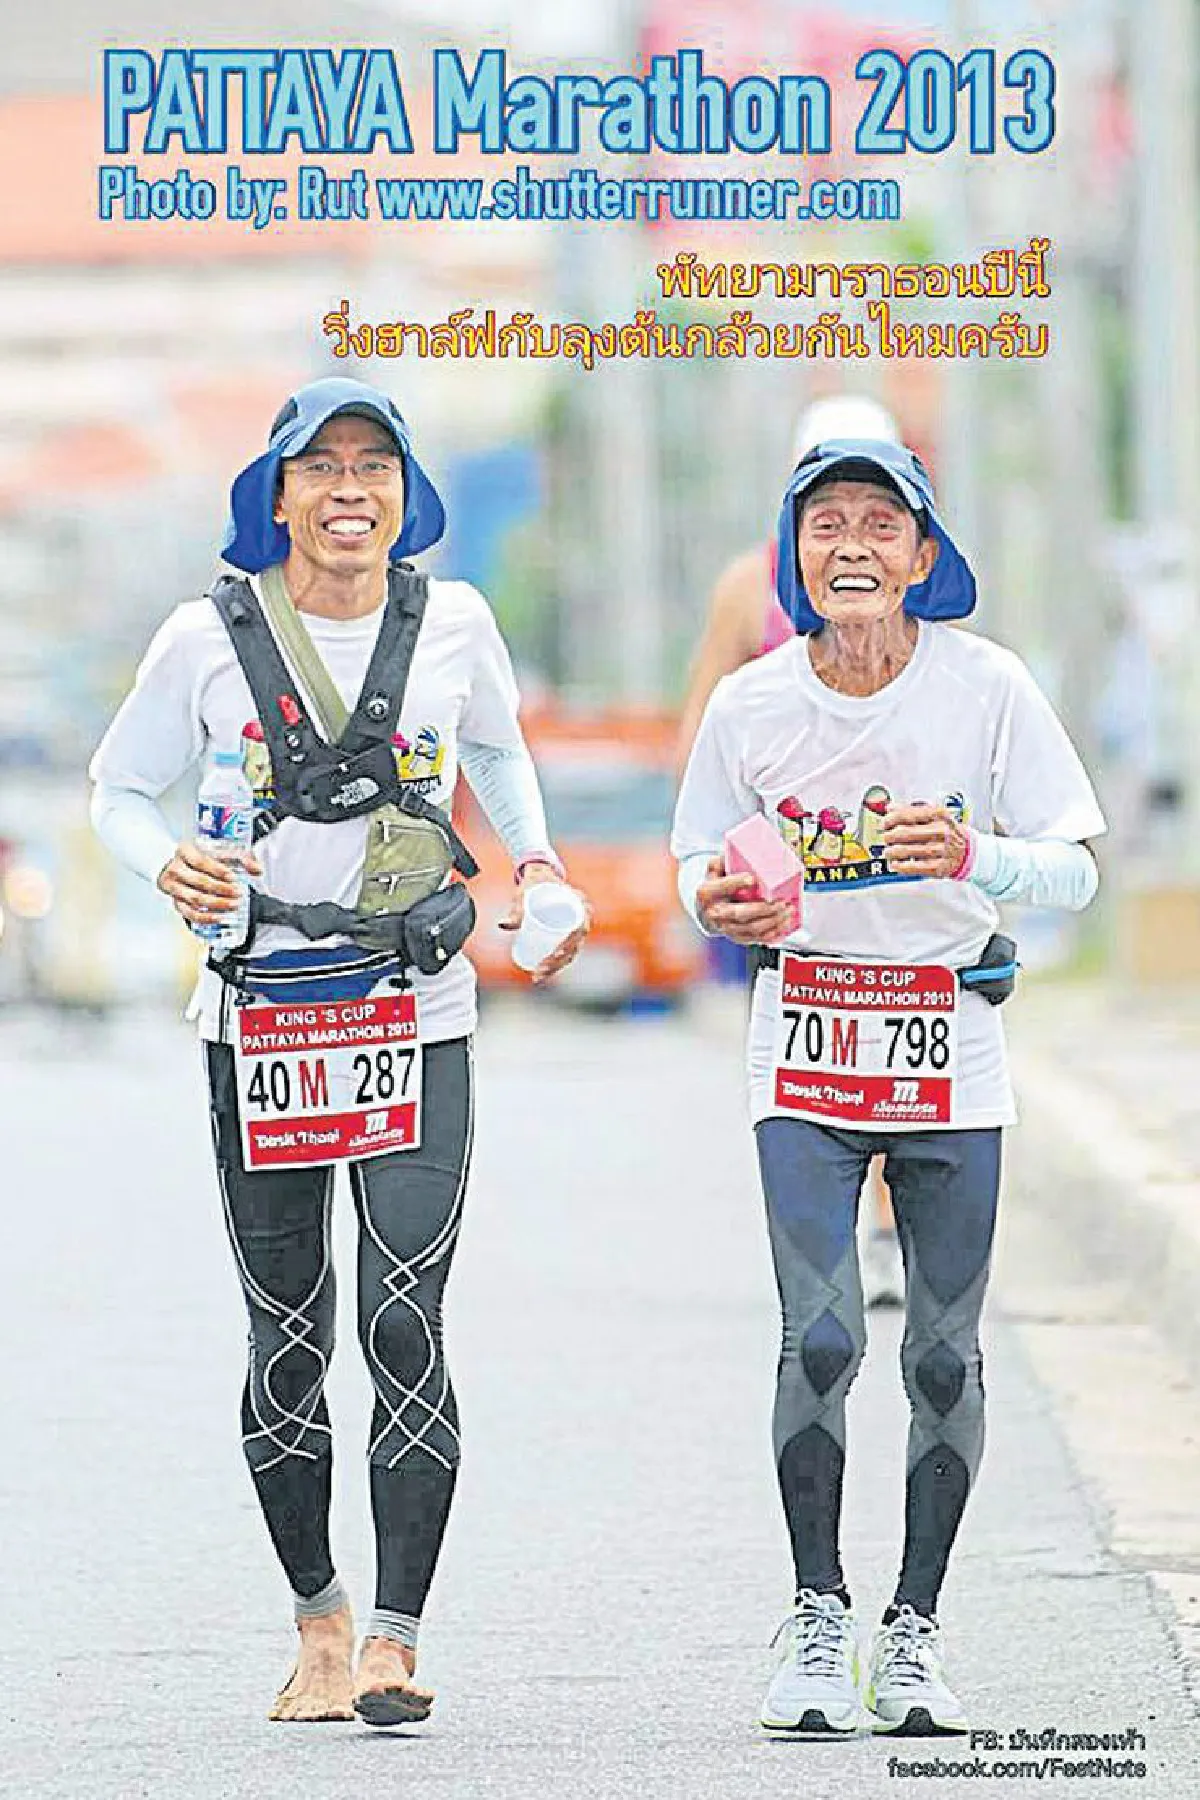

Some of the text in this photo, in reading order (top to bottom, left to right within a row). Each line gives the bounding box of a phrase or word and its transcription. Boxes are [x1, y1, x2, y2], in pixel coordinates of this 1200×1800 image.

[815, 966, 856, 984] KING
[881, 970, 916, 987] CUP
[784, 984, 953, 1006] PATTAYA MARATHON 2013
[275, 1010, 317, 1026] KING
[341, 1004, 376, 1022] CUP
[242, 1022, 415, 1049] PATTAYA MARATHON 2013
[783, 1009, 950, 1070] 70 M 798
[247, 1048, 416, 1112] 40 M 287
